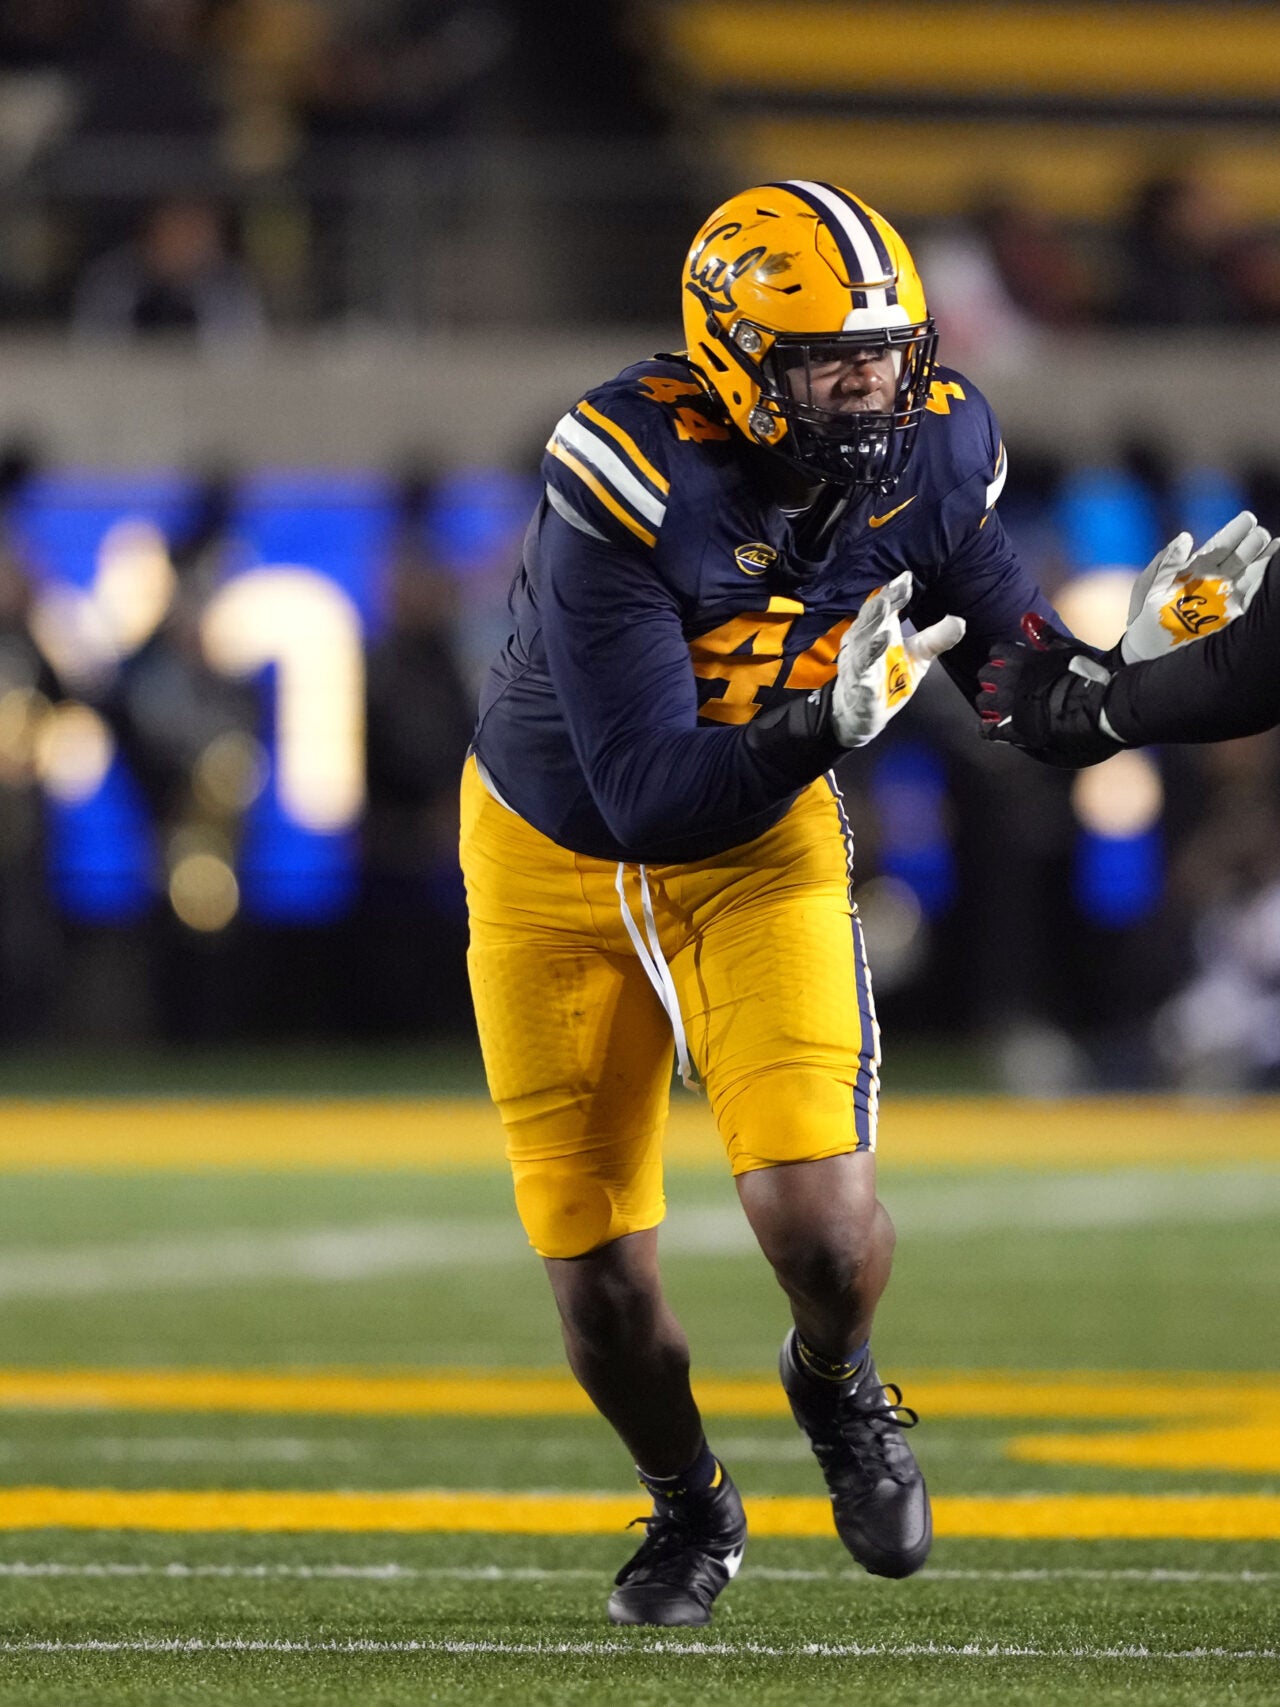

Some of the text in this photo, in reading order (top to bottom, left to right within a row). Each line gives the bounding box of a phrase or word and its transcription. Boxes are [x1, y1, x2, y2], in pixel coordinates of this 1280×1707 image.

[685, 222, 767, 313] Cal
[638, 376, 731, 443] 44
[739, 549, 776, 566] ACC
[1170, 595, 1219, 634] Cal
